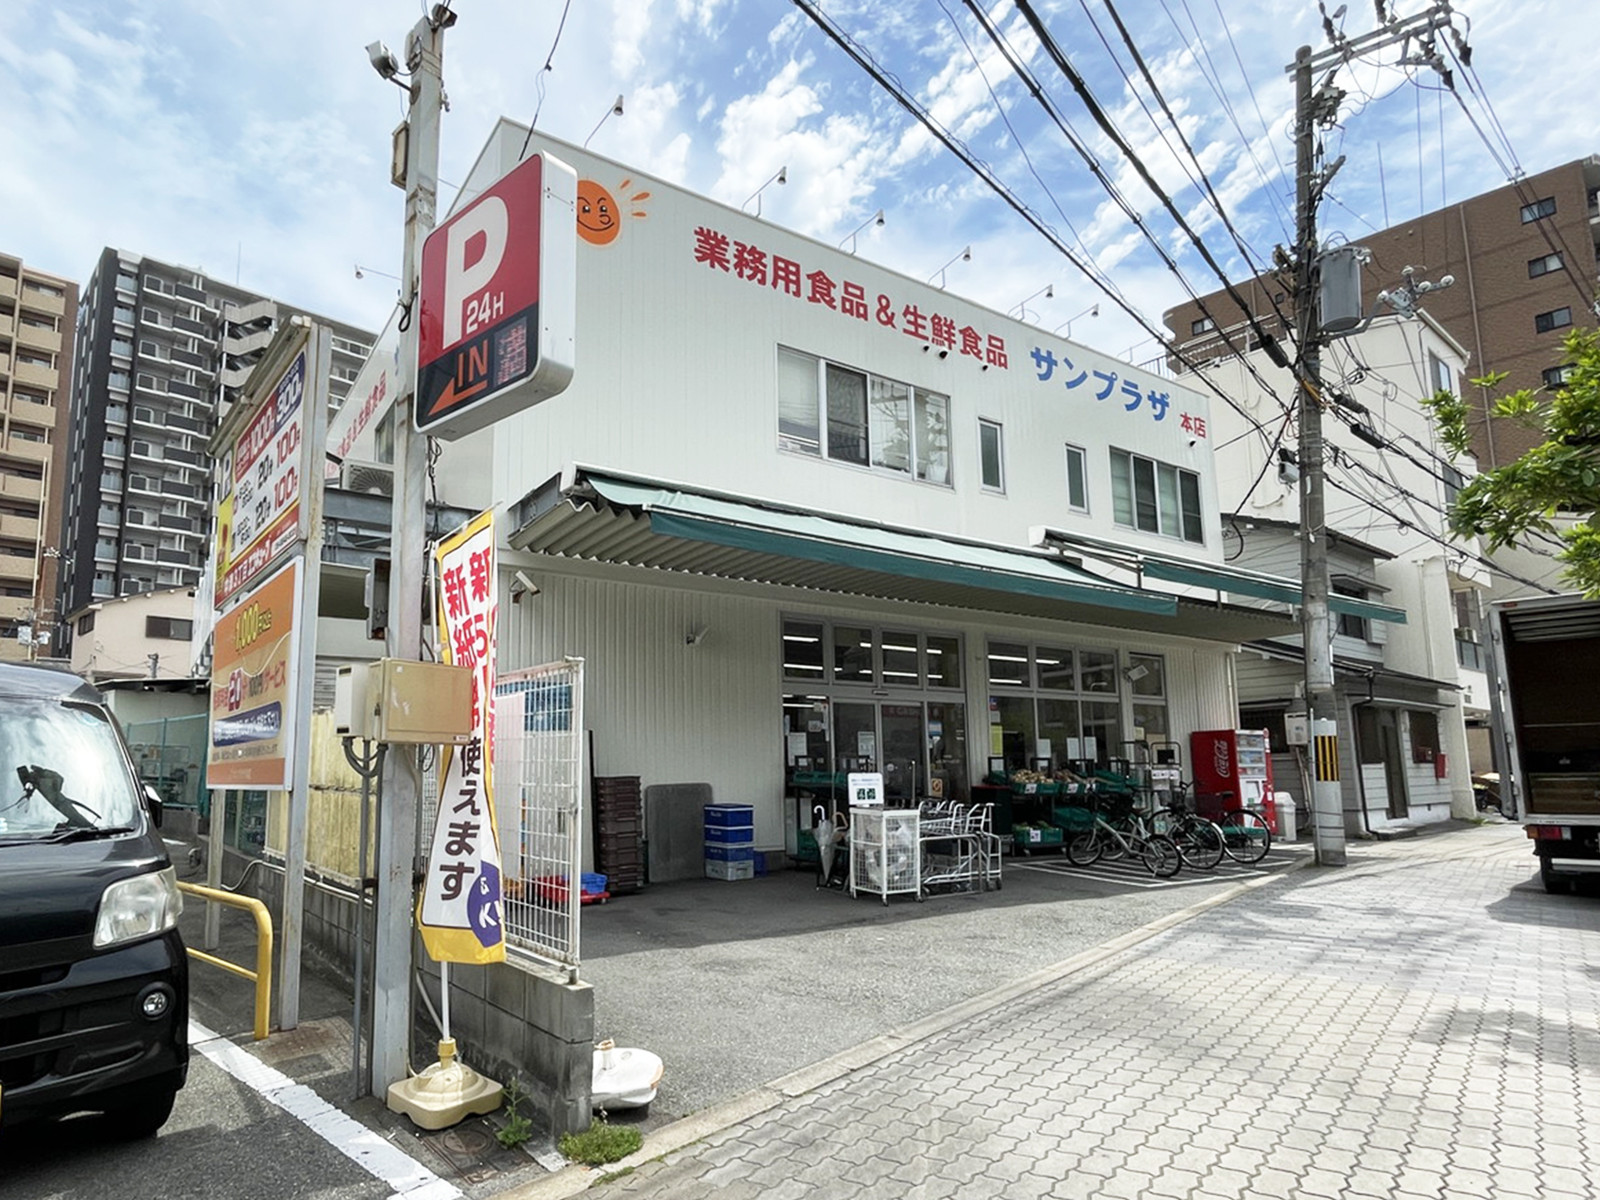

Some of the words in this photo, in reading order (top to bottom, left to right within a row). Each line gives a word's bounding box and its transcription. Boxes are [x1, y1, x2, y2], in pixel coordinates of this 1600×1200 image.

[443, 196, 509, 350] P
[465, 291, 504, 335] 24H
[457, 339, 488, 388] IN
[693, 226, 1008, 369] 業務用食品&生鮮食品
[1030, 347, 1170, 421] サンプラザ
[1180, 412, 1206, 438] 本店
